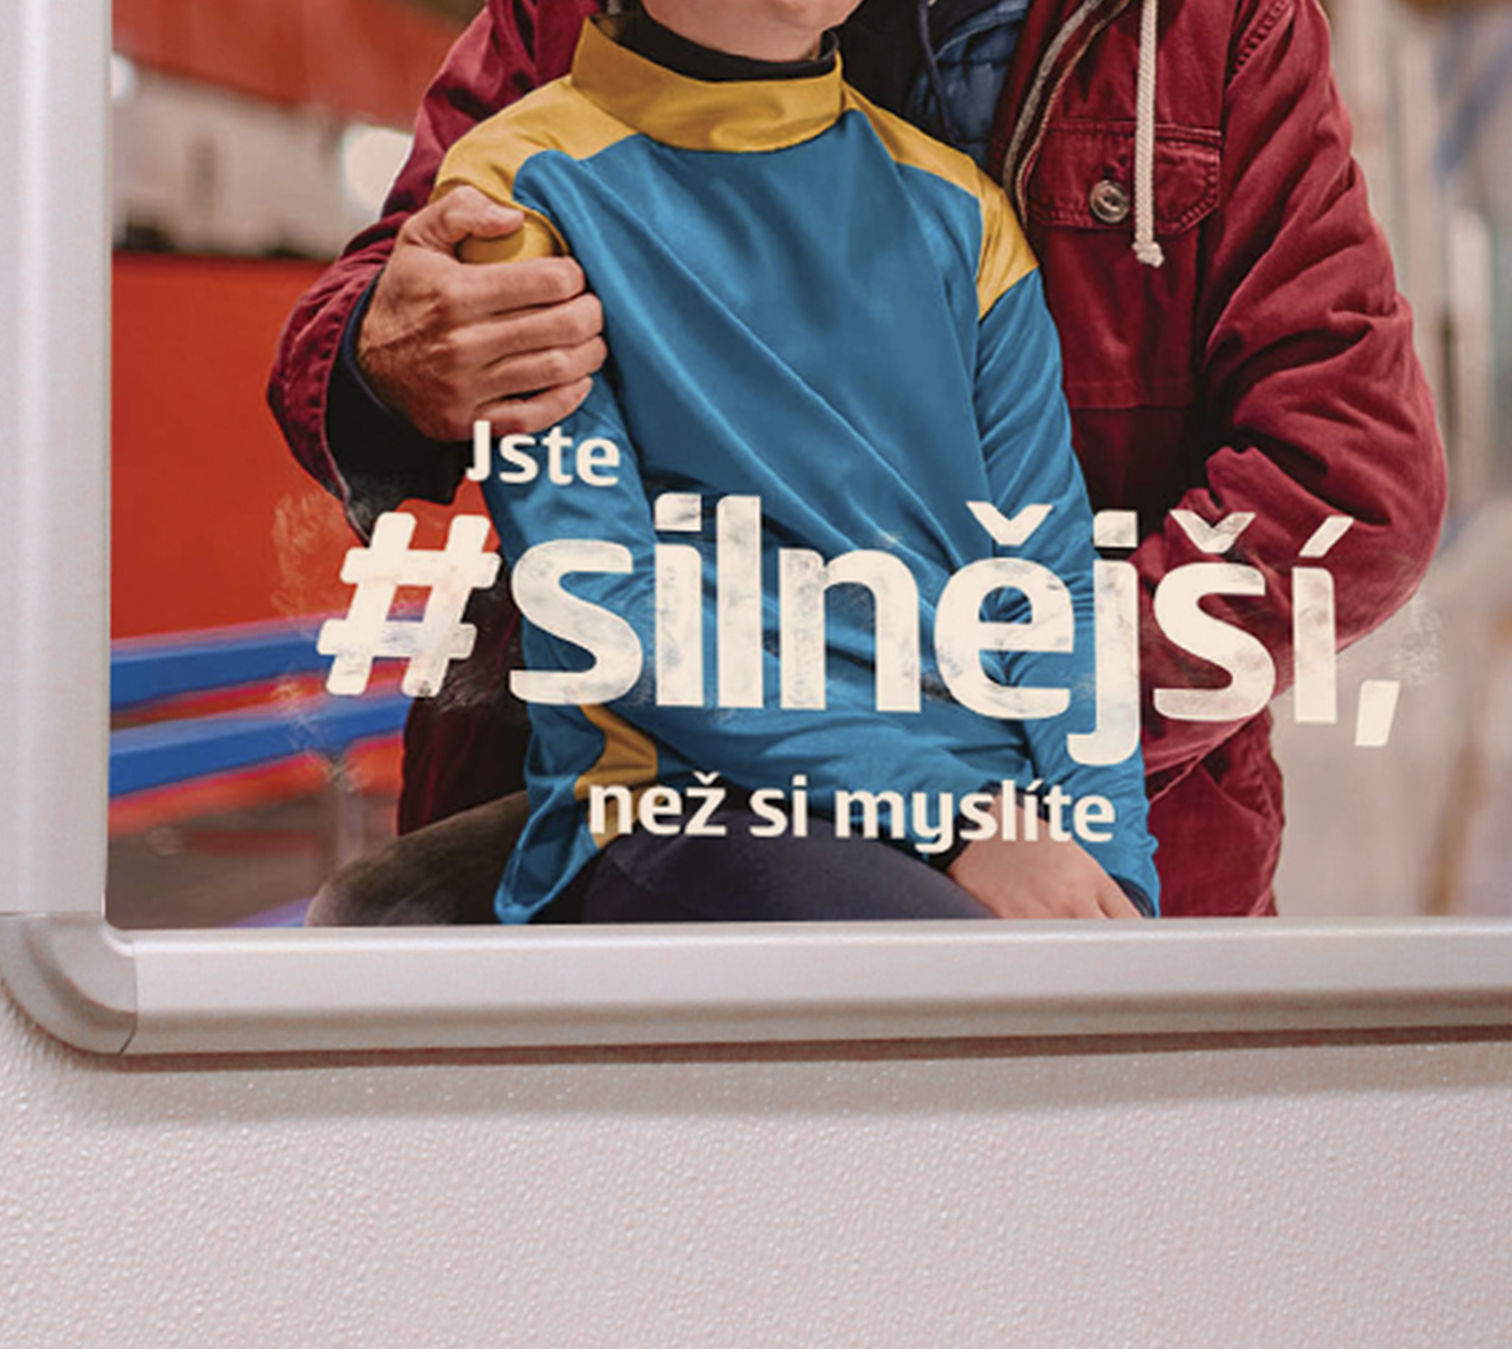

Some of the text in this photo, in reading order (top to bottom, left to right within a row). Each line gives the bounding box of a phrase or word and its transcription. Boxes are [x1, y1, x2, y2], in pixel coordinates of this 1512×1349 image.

[466, 419, 620, 486] Jste
[317, 493, 1401, 767] #silnější,
[589, 771, 1116, 854] než si myslíte
